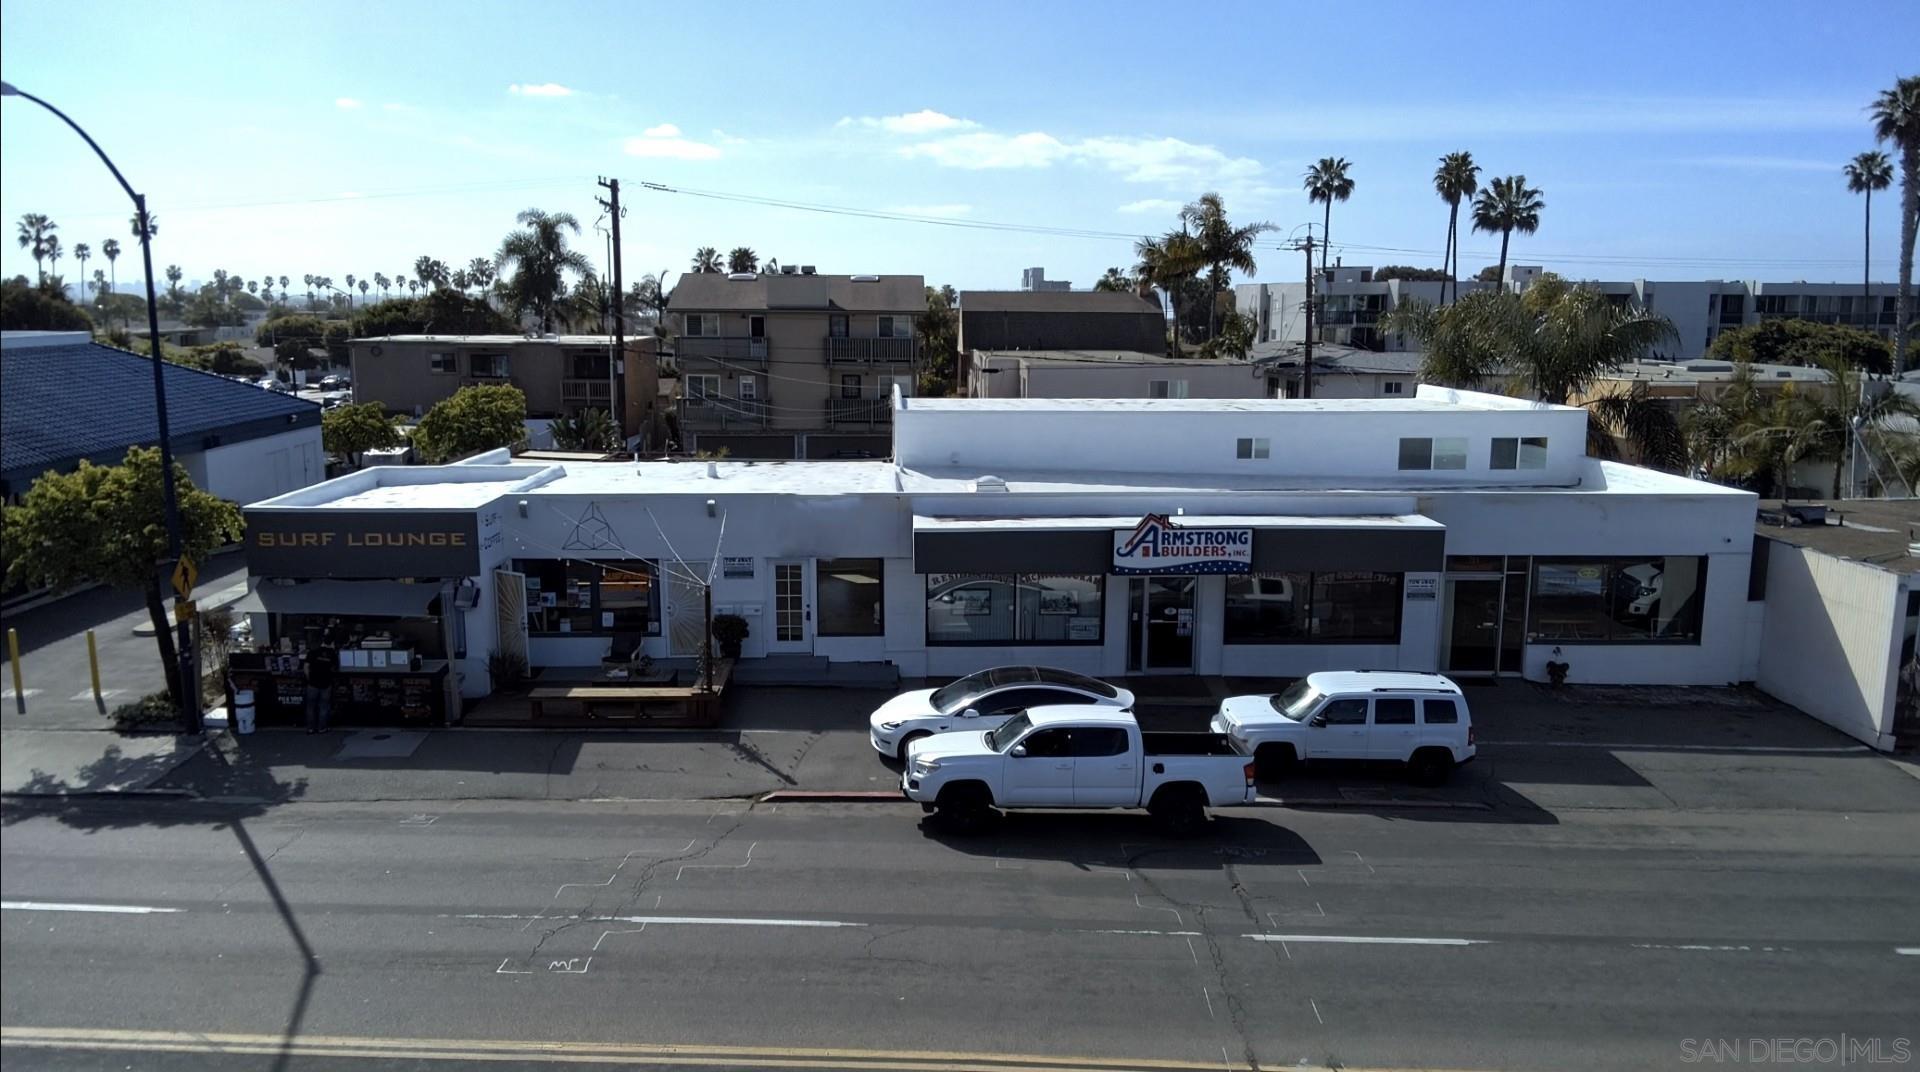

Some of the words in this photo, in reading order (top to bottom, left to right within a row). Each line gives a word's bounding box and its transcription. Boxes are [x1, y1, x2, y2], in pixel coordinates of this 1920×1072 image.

[257, 532, 336, 547] SURF
[347, 532, 467, 547] LOUNGE
[1116, 524, 1249, 557] ARMSTRONG
[1161, 546, 1232, 558] BUILDERS,
